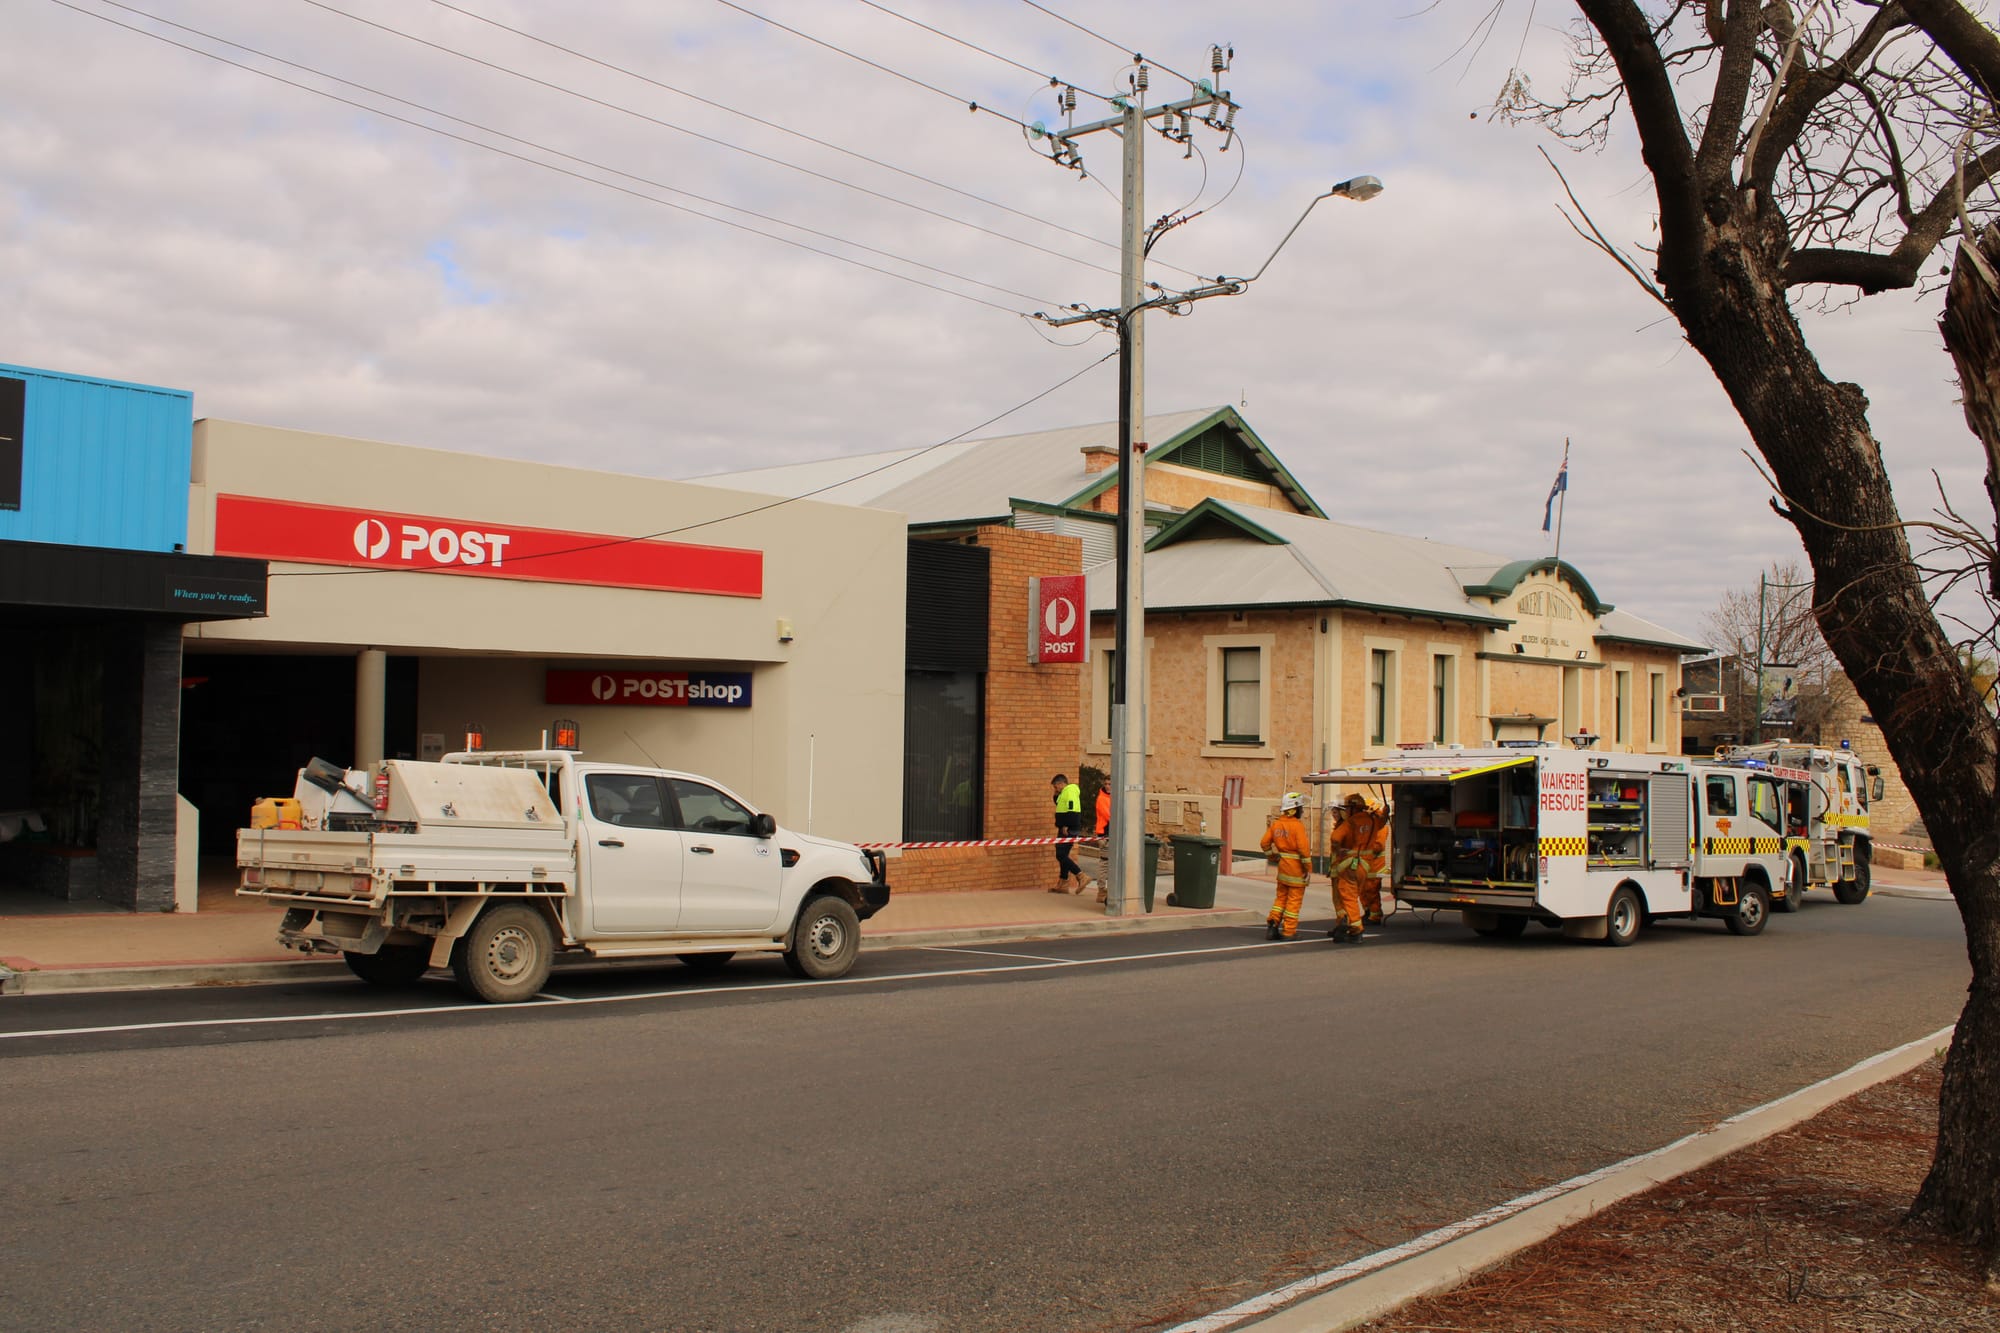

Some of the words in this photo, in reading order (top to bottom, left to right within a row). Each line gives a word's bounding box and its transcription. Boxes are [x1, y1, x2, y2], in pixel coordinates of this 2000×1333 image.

[401, 525, 510, 567] POST
[174, 588, 198, 599] When
[199, 591, 227, 601] you're
[229, 594, 257, 603] ready...
[1044, 641, 1076, 654] POST
[623, 679, 743, 703] POSTshop
[1540, 772, 1585, 790] WAIKERIE
[1540, 793, 1585, 811] RESCUE
